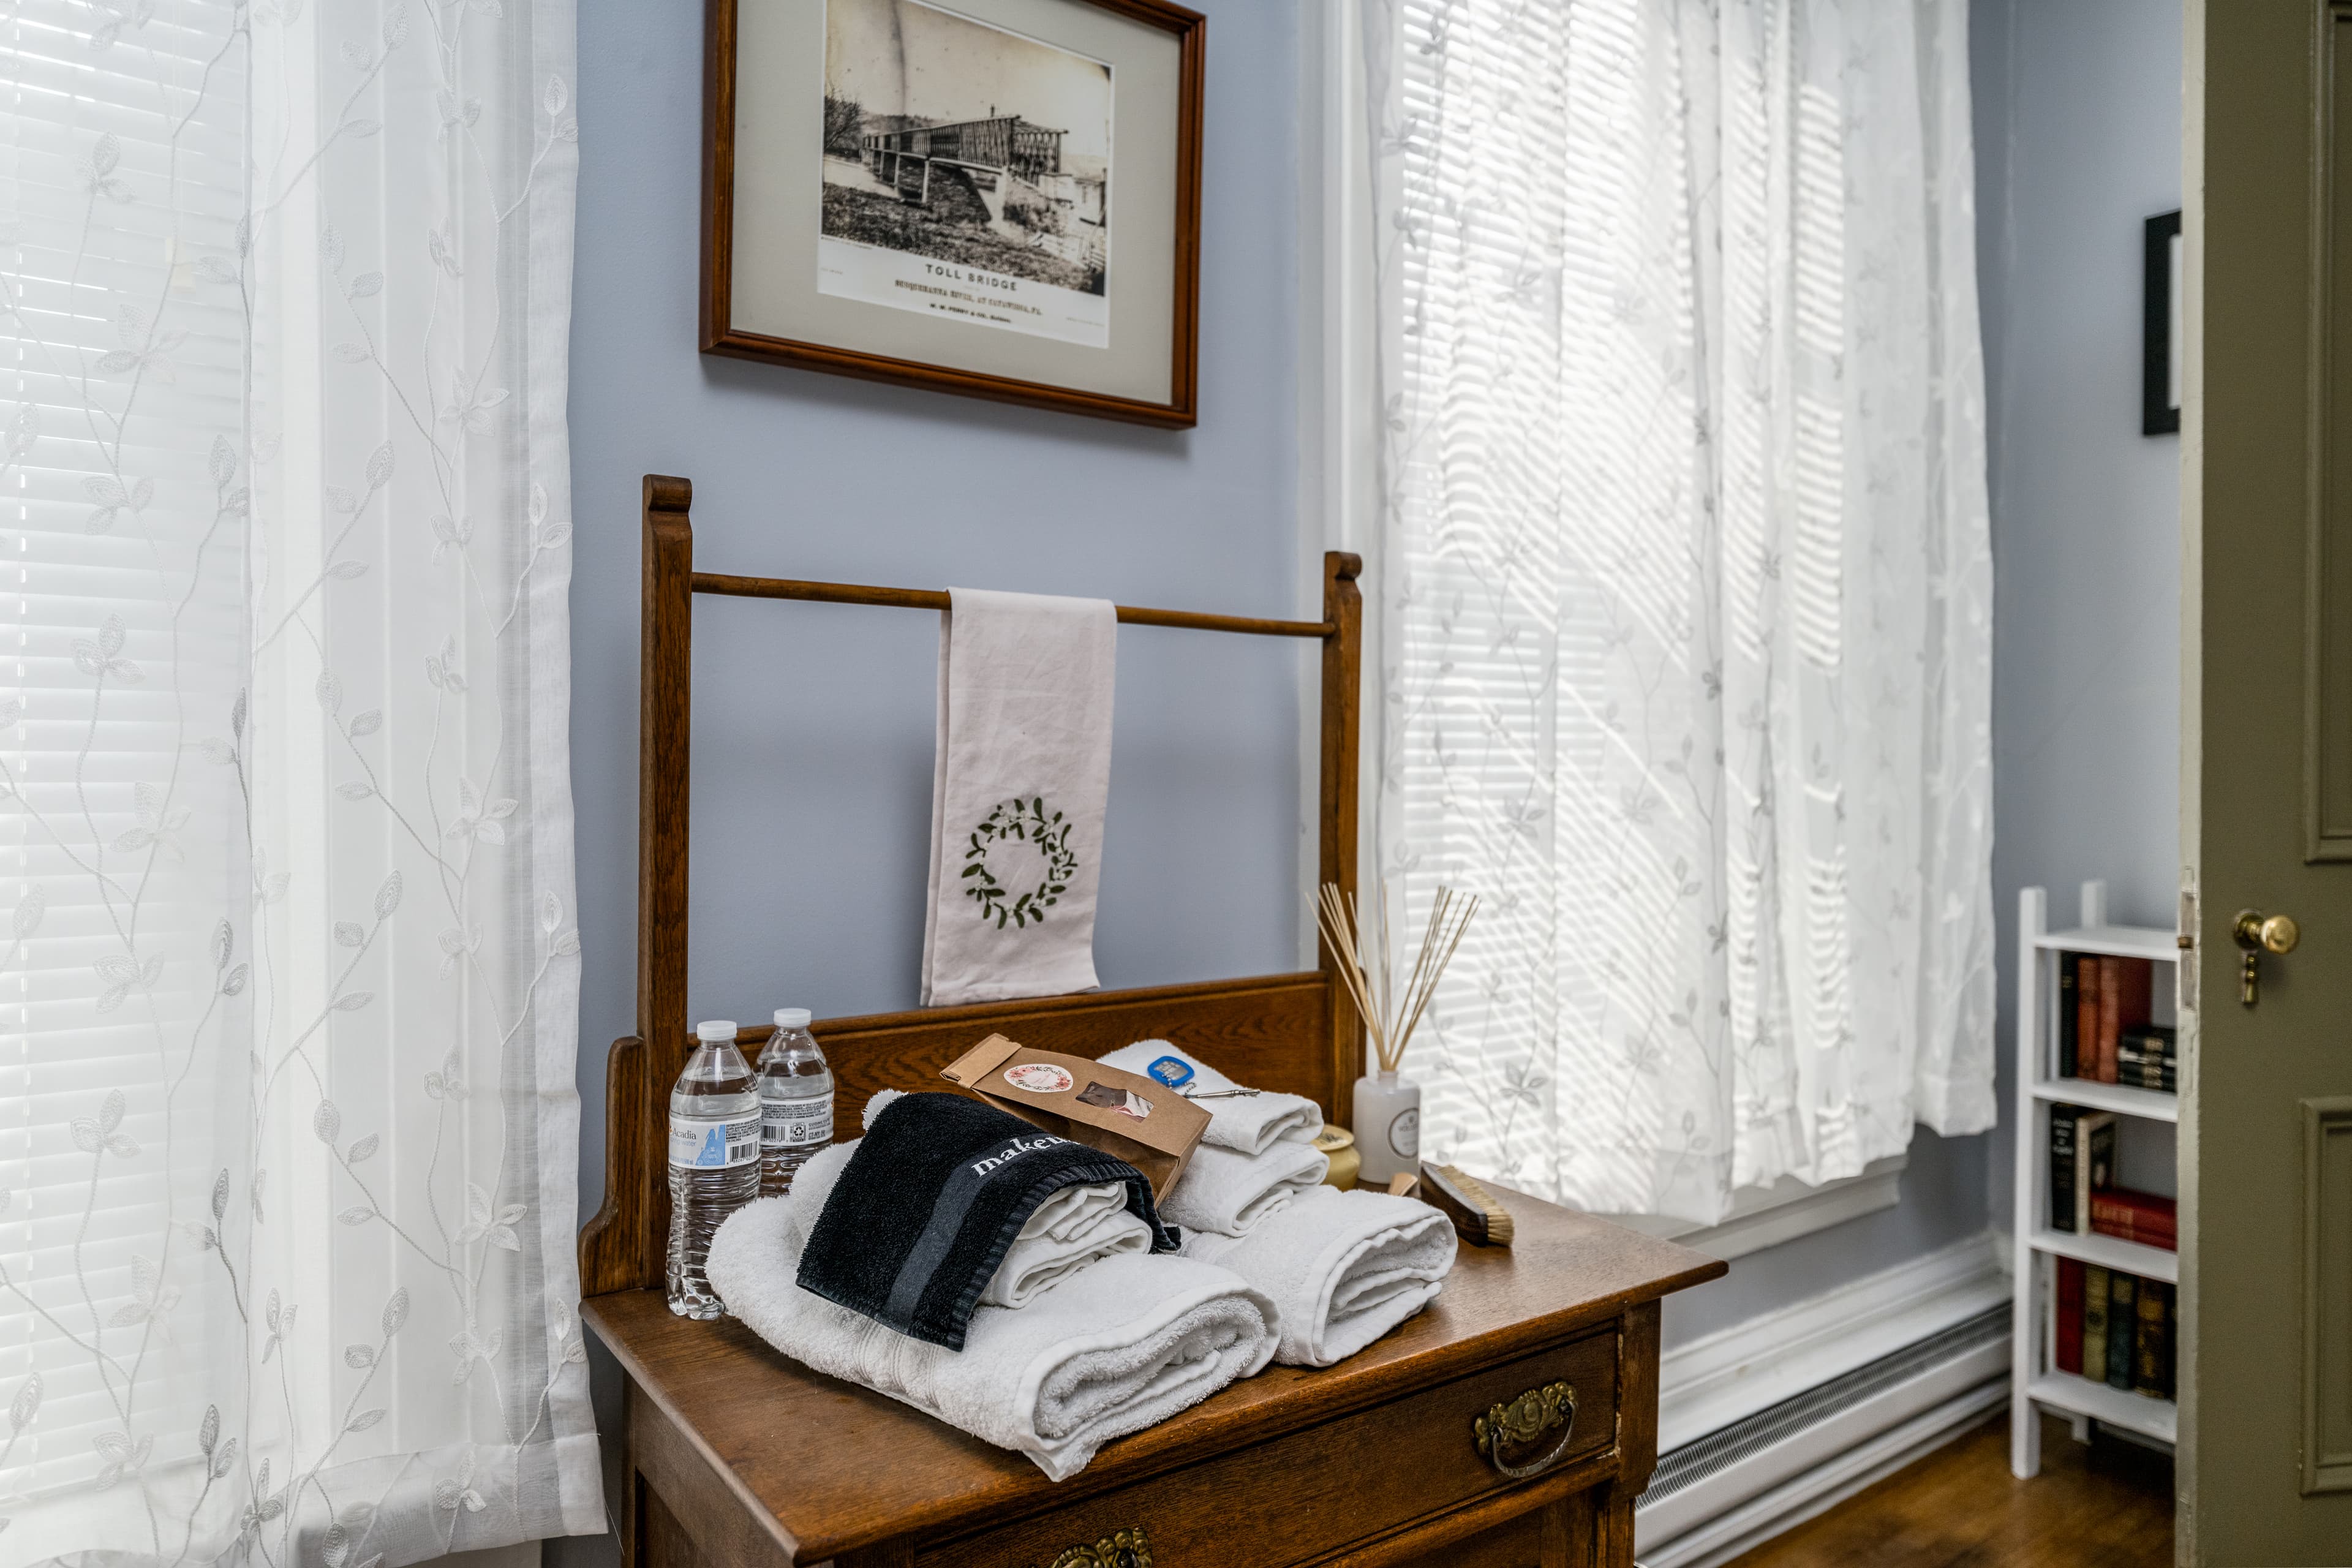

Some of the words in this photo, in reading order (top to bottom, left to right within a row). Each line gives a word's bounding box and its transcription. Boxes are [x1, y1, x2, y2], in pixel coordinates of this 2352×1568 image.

[925, 263, 962, 280] TOLL
[967, 272, 1018, 292] BRIDGE
[673, 1127, 696, 1140] Acadia
[971, 1136, 1080, 1177] makeu
